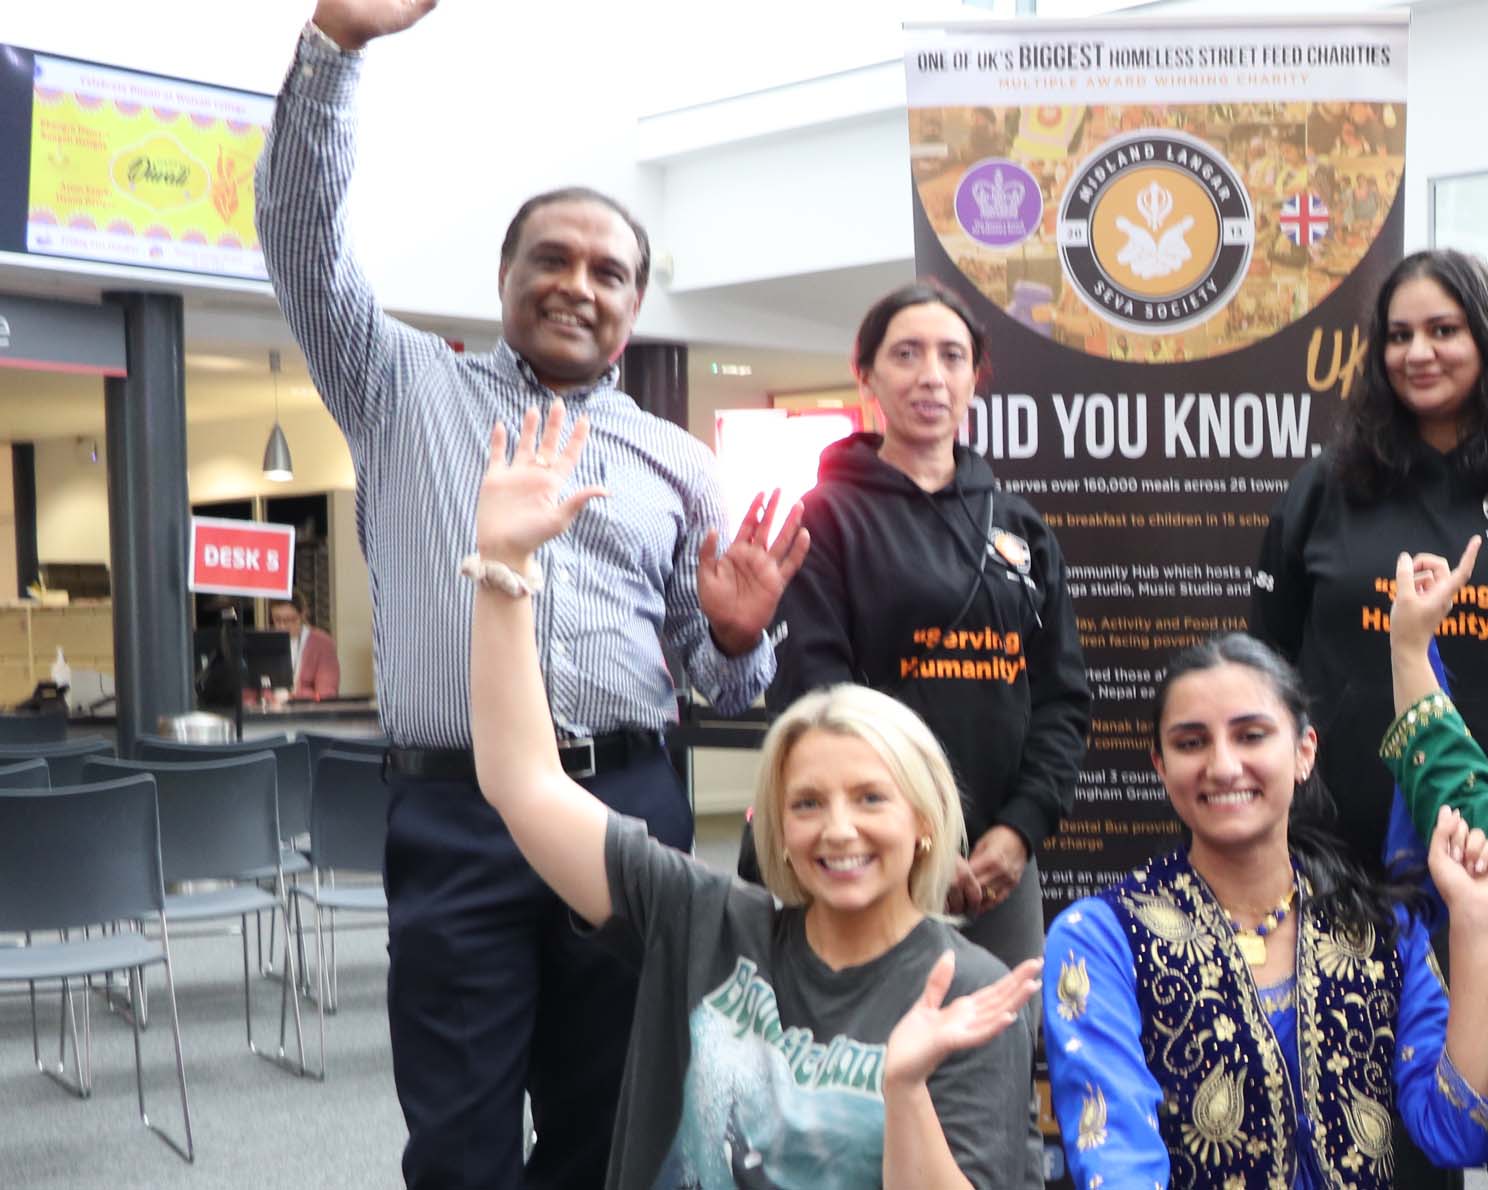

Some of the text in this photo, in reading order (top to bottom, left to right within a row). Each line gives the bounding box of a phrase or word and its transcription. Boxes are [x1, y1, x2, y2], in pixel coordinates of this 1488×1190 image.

[918, 42, 1391, 72] ONE OF UK'S BIGGEST HOMELESS STREET FEED CHARITIES
[999, 74, 1309, 89] MULTIPLE AWARD WINNING CHARITY
[1079, 143, 1231, 204] MIDLAND LANGAR
[1094, 278, 1218, 320] SEVA SOCIETY
[959, 393, 1039, 460] DID
[1053, 392, 1149, 459] YOU
[1006, 479, 1048, 493] serves
[1051, 479, 1081, 493] over
[1141, 476, 1180, 493] meals
[1184, 479, 1227, 493] across
[1067, 512, 1127, 528] breakfast
[1131, 512, 1145, 527] to
[1148, 512, 1201, 528] children
[1206, 512, 1218, 527] in
[205, 544, 260, 571] DESK
[1132, 564, 1160, 579] Hub
[1163, 563, 1202, 579] which
[1206, 563, 1241, 579] hosts
[1091, 581, 1135, 598] studio,
[1138, 581, 1176, 597] Music
[1180, 581, 1223, 597] Studio
[1227, 581, 1251, 597] and
[1101, 616, 1151, 631] Activity
[1155, 616, 1180, 630] and
[1184, 616, 1218, 630] Food
[1109, 634, 1149, 650] facing
[1115, 667, 1151, 682] those
[1098, 684, 1137, 701] Nepal
[1091, 718, 1132, 733] Nanak
[1126, 786, 1166, 801] Grand
[1059, 819, 1101, 833] Dental
[1105, 819, 1129, 833] Bus
[1043, 835, 1057, 849] of
[1052, 870, 1073, 884] out
[1077, 872, 1093, 884] an
